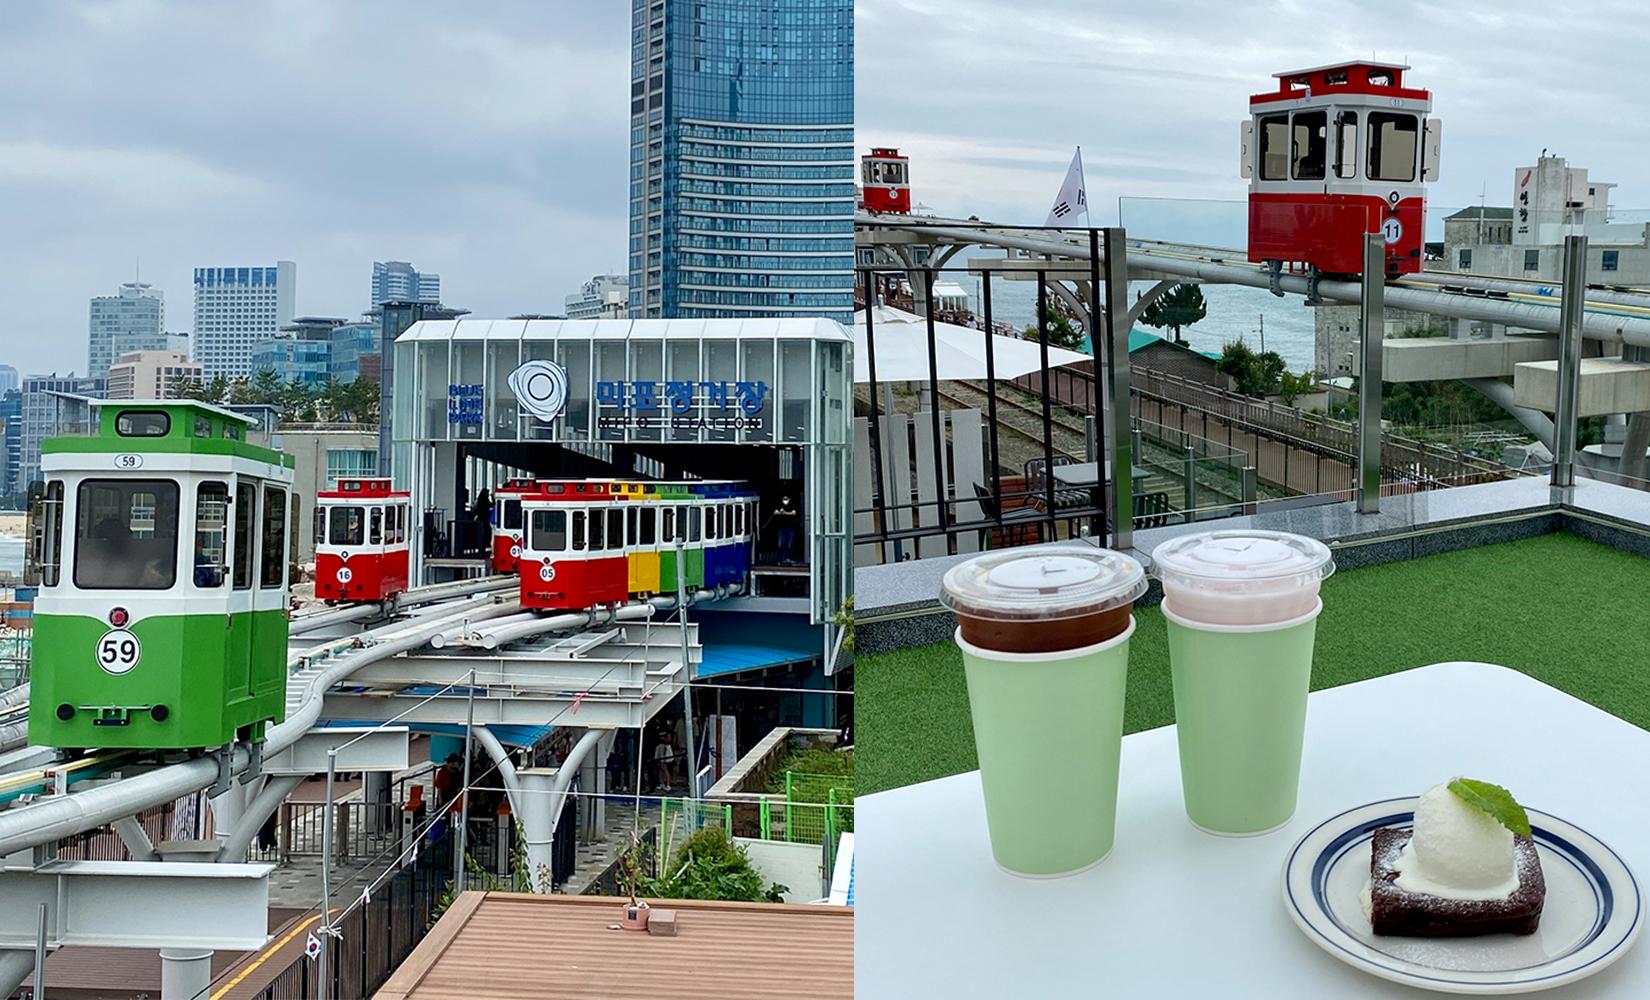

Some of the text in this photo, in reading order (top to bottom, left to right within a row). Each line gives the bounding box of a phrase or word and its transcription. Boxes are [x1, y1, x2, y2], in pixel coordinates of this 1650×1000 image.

[1384, 225, 1399, 238] 11
[597, 380, 768, 414] 미포정거장
[122, 456, 136, 467] 59
[338, 570, 351, 580] 16
[541, 568, 554, 578] 05
[101, 639, 136, 664] 59
